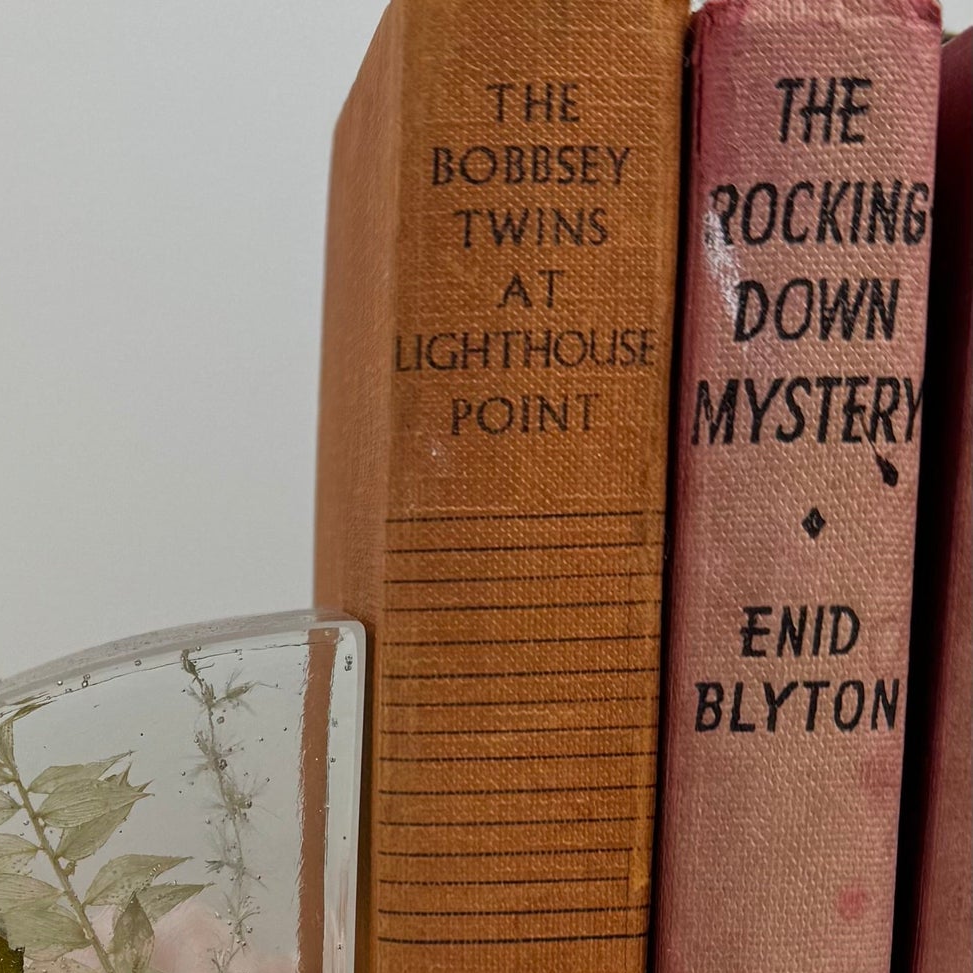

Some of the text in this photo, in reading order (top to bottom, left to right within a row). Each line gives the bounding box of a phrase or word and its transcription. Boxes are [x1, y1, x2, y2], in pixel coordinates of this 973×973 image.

[486, 82, 580, 123] THE
[775, 76, 873, 144] THE
[431, 146, 631, 185] BOBBSEY
[454, 208, 609, 248] TWINS
[497, 270, 565, 308] AT
[734, 278, 900, 342] DOWN
[395, 329, 656, 372] LIGHTHOUSE
[450, 393, 601, 436] POINT
[691, 375, 924, 446] MYSTERY
[740, 605, 861, 657] ENID
[694, 678, 900, 732] BLYTON
